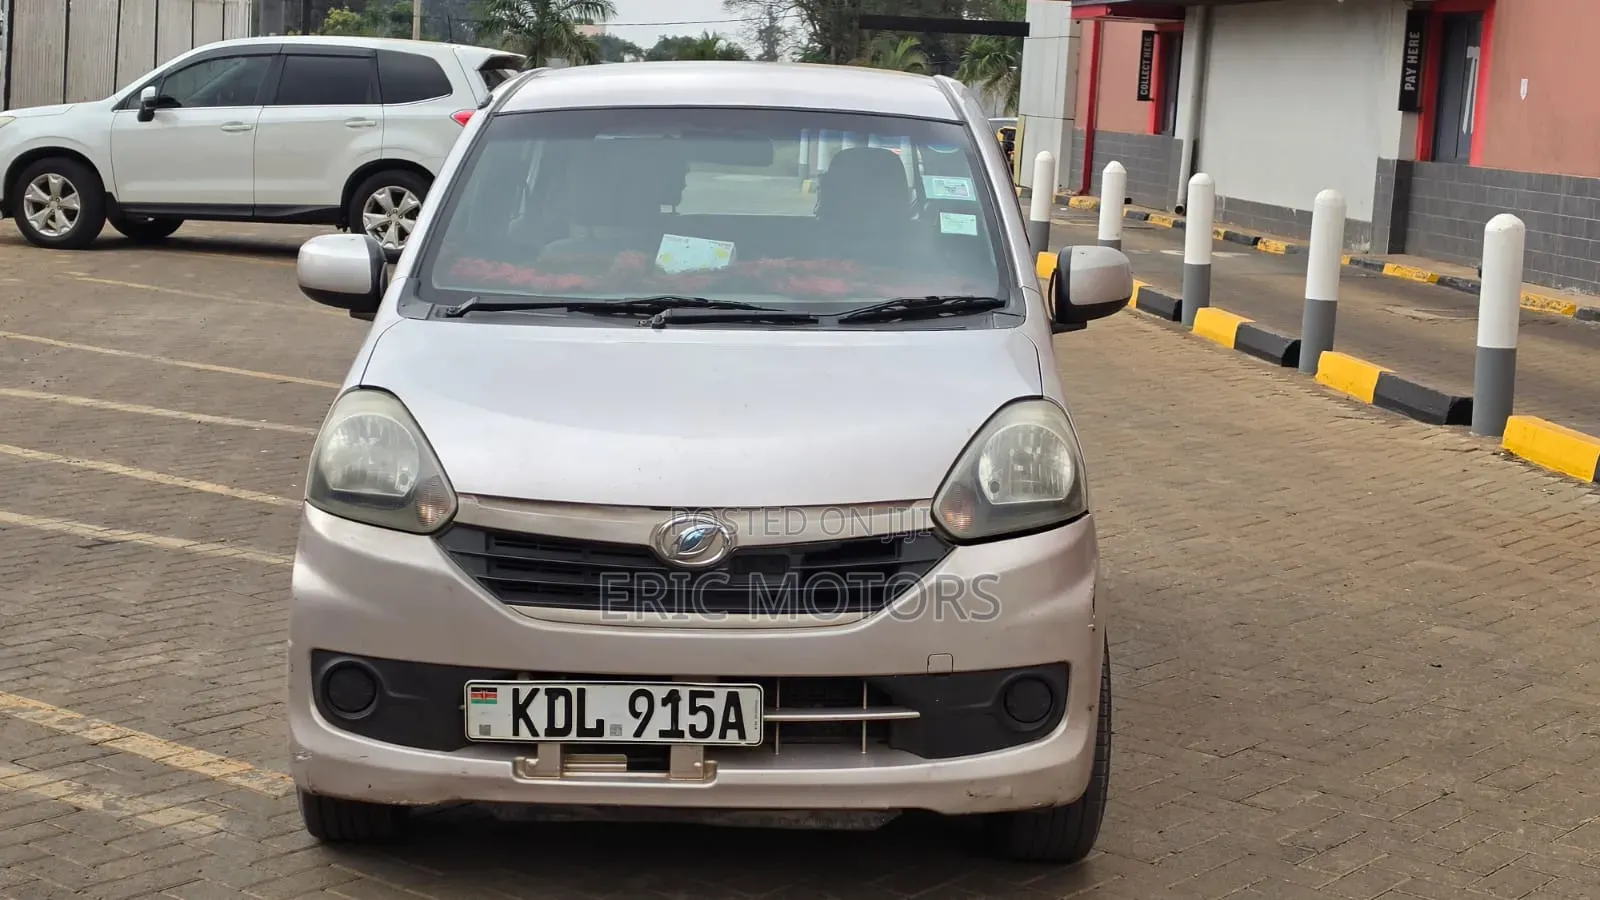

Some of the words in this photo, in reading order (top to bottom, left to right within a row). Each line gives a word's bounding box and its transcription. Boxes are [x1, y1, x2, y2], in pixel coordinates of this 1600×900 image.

[1143, 36, 1152, 58] HERE
[1406, 31, 1420, 64] HERE
[1140, 59, 1151, 95] COLLECT
[1404, 67, 1417, 91] PAY
[511, 687, 605, 738] KDL
[628, 688, 747, 740] 915A
